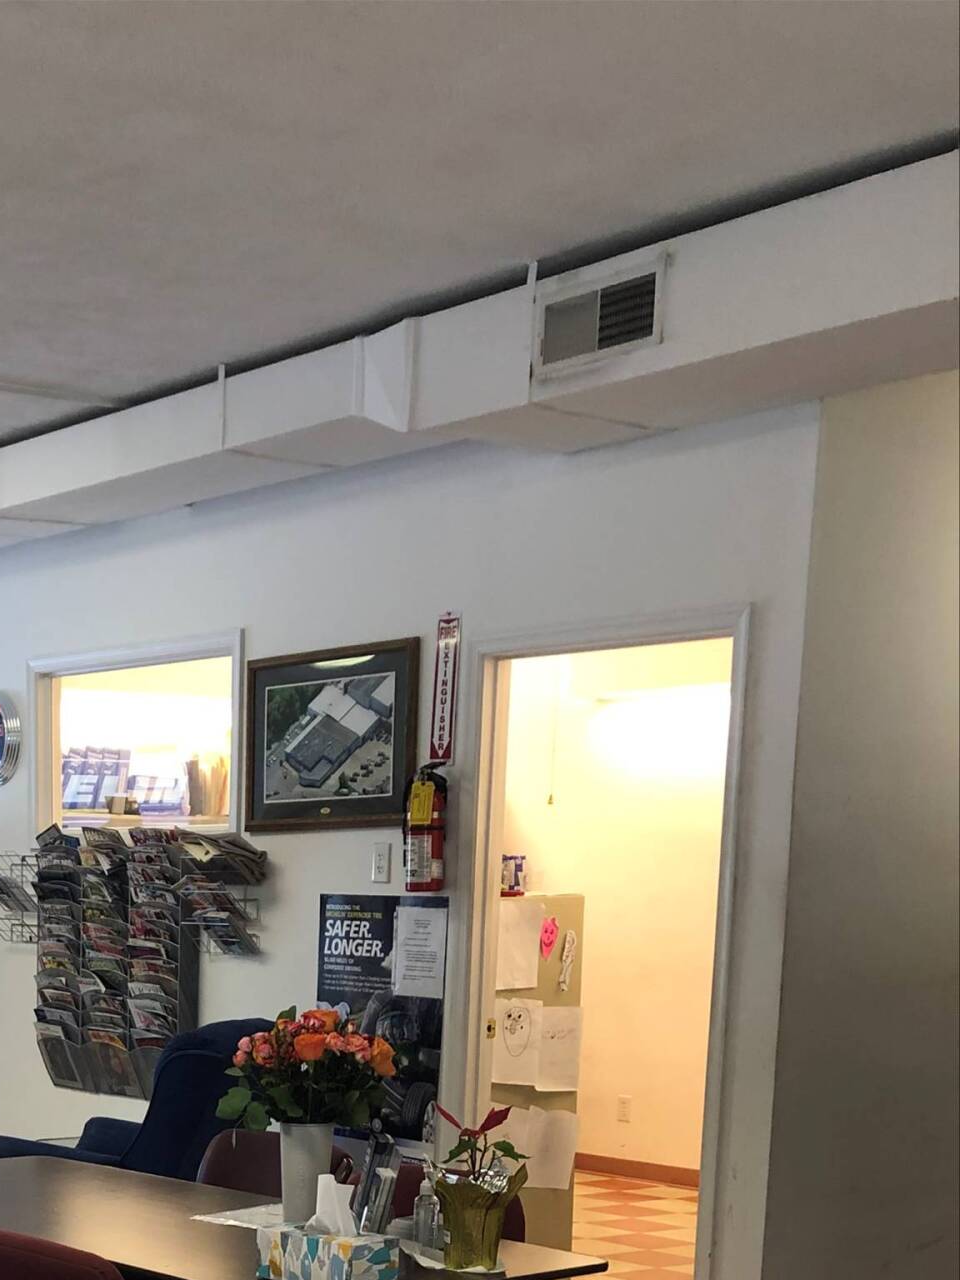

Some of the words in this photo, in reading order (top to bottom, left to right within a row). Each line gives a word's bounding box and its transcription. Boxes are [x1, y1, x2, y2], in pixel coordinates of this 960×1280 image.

[440, 626, 457, 640] FIRE
[437, 642, 451, 751] EXTINGUISHER
[324, 919, 373, 939] SAFER.
[323, 937, 385, 958] LONGER.
